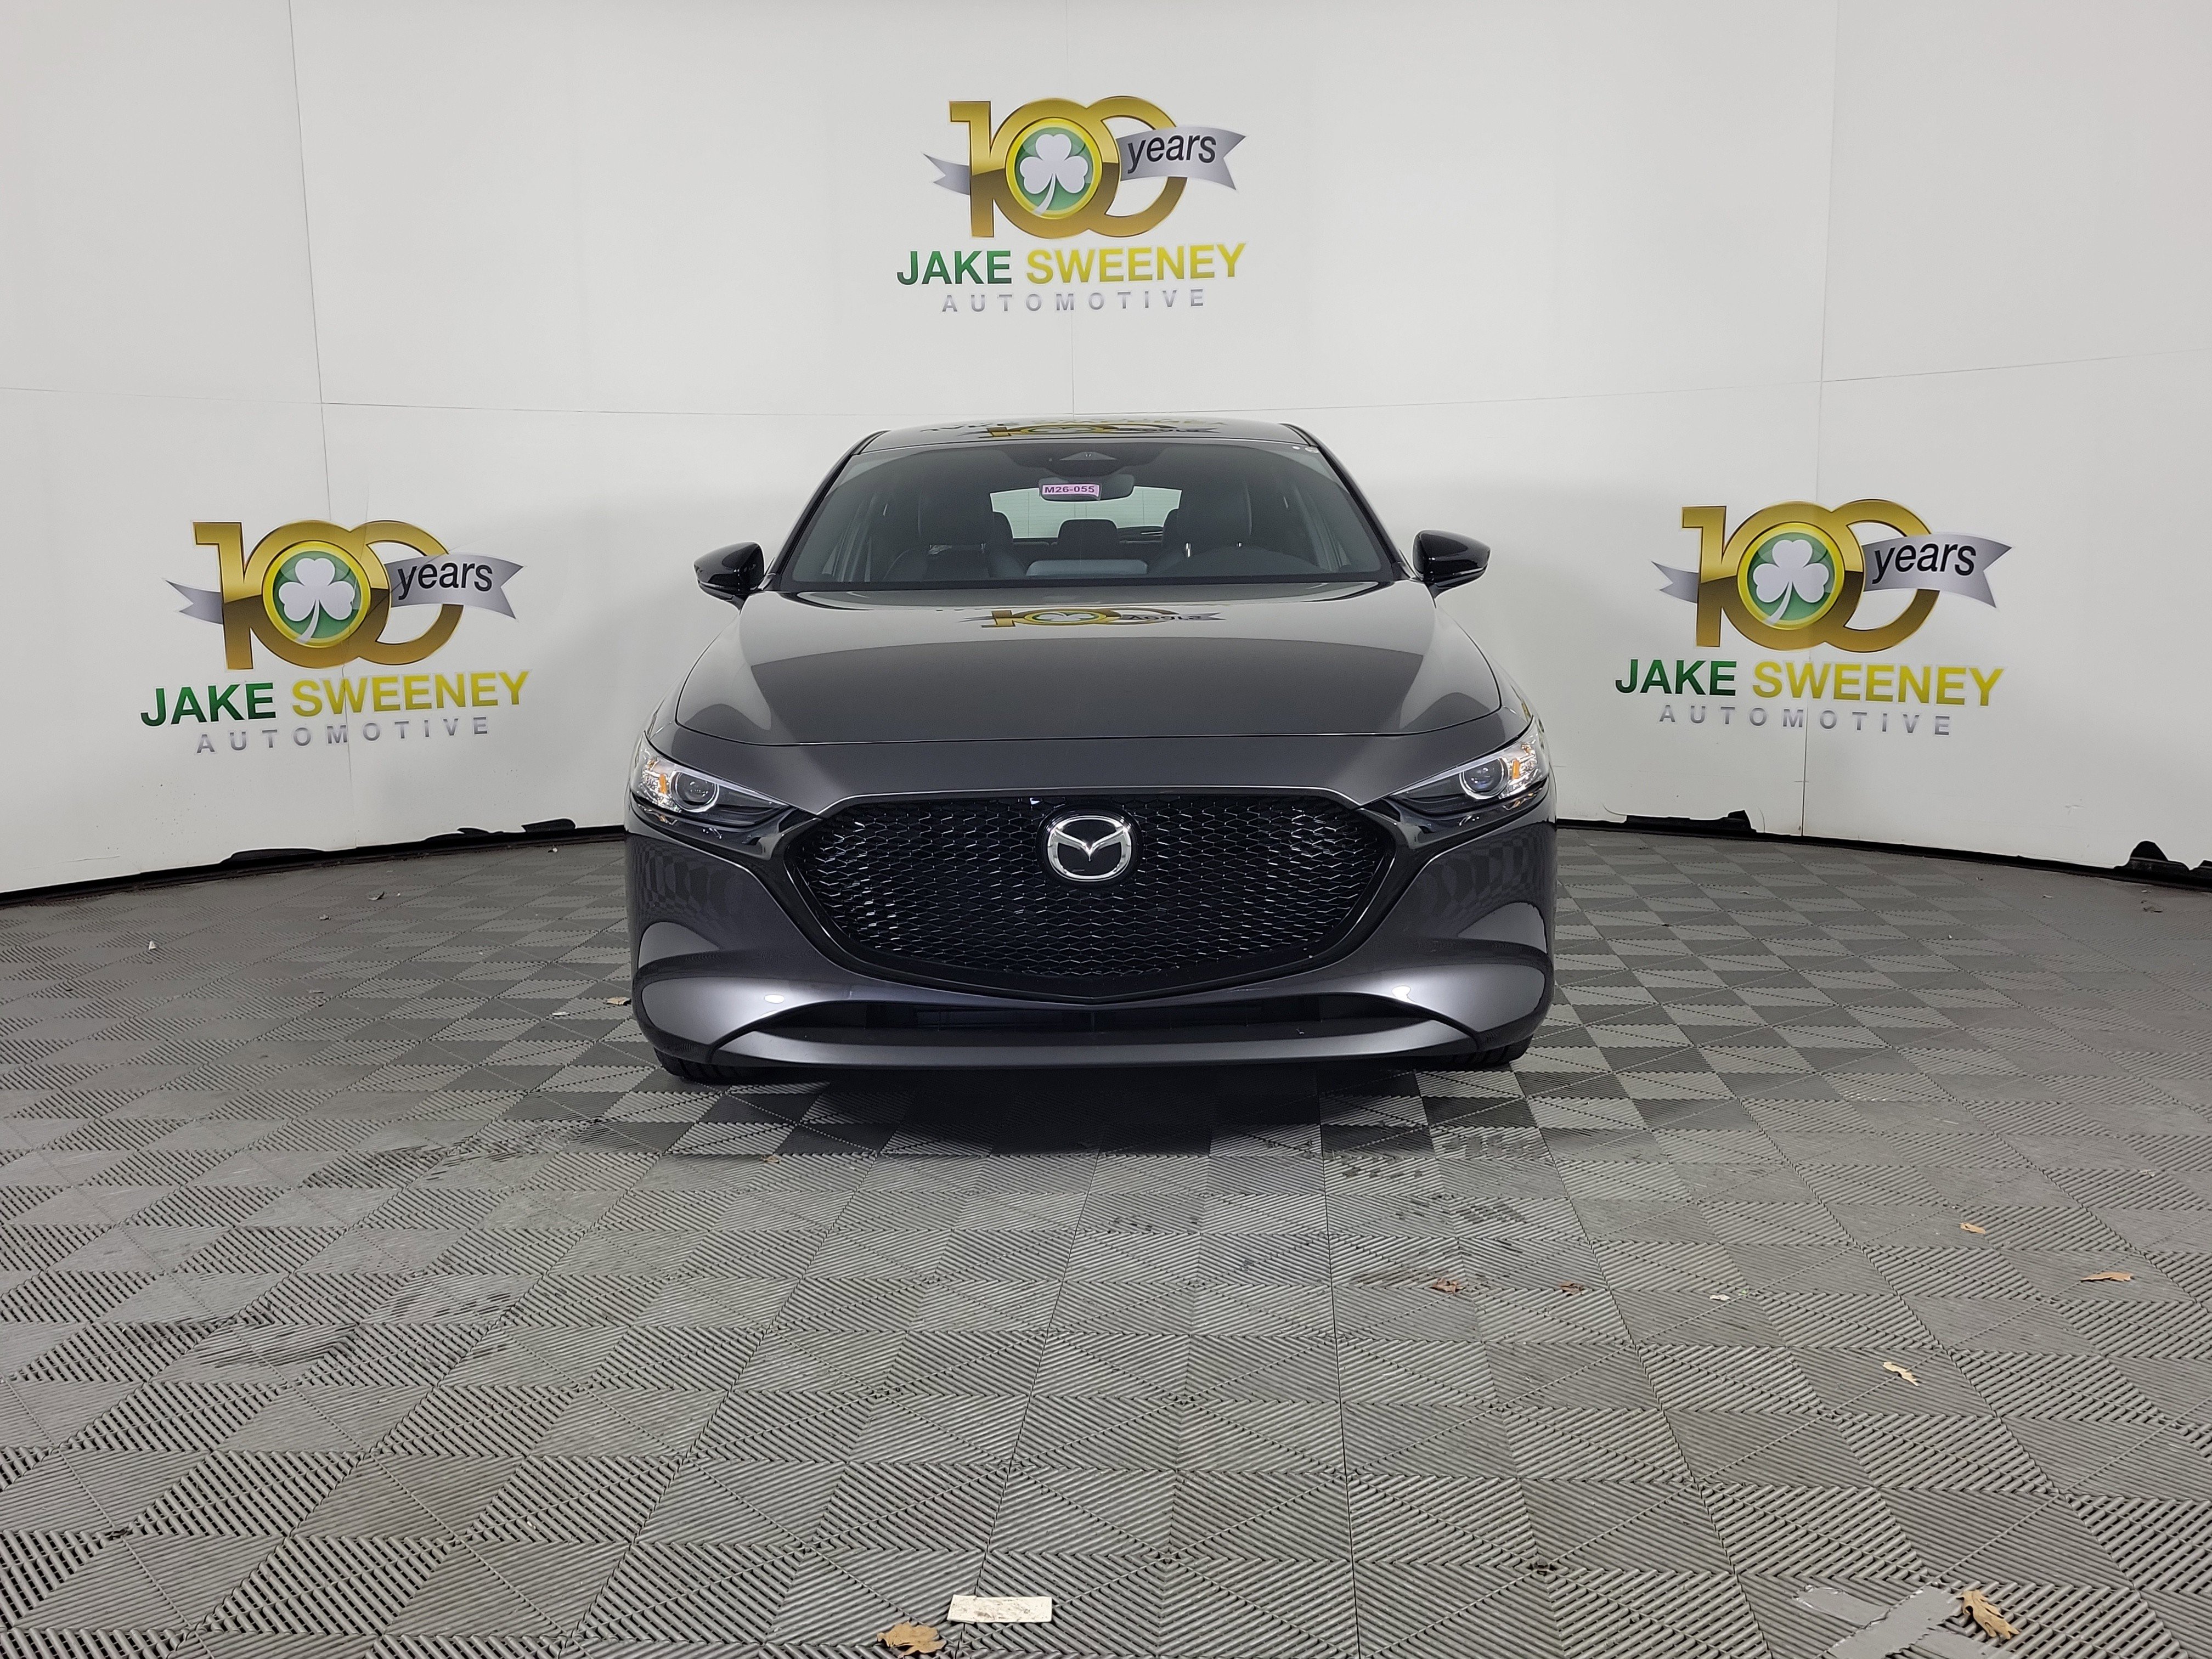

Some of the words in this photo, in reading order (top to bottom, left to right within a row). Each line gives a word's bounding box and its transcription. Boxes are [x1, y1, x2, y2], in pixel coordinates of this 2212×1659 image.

[949, 95, 1187, 239] 100
[1127, 134, 1217, 173] years
[897, 250, 1012, 285] JAKE
[1026, 244, 1246, 284] SWEENEY
[942, 289, 1204, 313] AUTOMOTIVE
[192, 520, 464, 670] 100
[398, 562, 493, 601] years
[1682, 498, 1940, 654] 100
[1872, 543, 1976, 584] years
[140, 681, 276, 727] JAKE
[292, 671, 530, 716] SWEENEY
[1615, 659, 1737, 696] JAKE
[1752, 661, 2005, 706] SWEENEY
[196, 717, 489, 754] AUTOMOTIVE
[1659, 705, 1950, 735] AUTOMOTIVE
